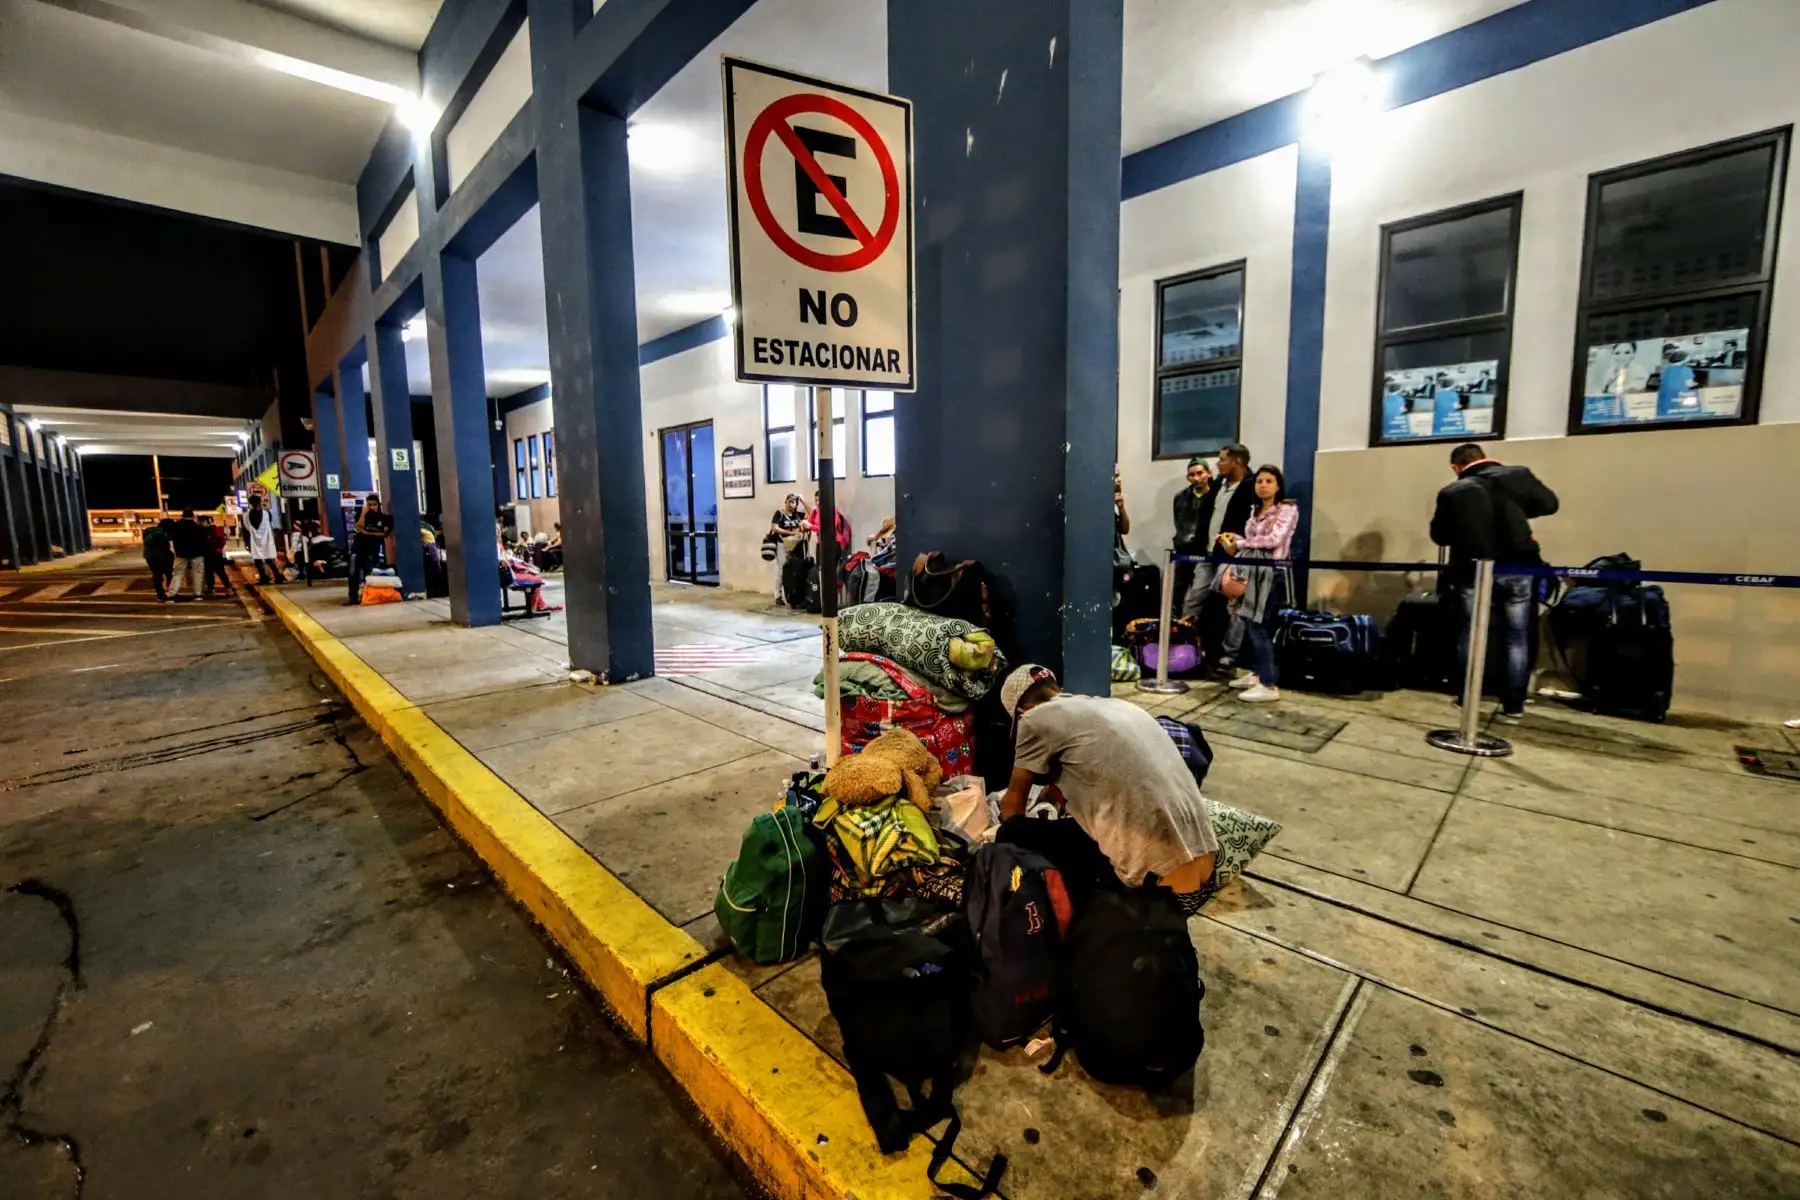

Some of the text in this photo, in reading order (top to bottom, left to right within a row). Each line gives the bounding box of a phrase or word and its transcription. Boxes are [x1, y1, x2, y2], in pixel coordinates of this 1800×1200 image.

[793, 125, 858, 241] E
[798, 288, 858, 328] NO
[753, 337, 901, 373] ESTACIONAR
[396, 451, 405, 461] S
[1735, 575, 1776, 583] CEBAF
